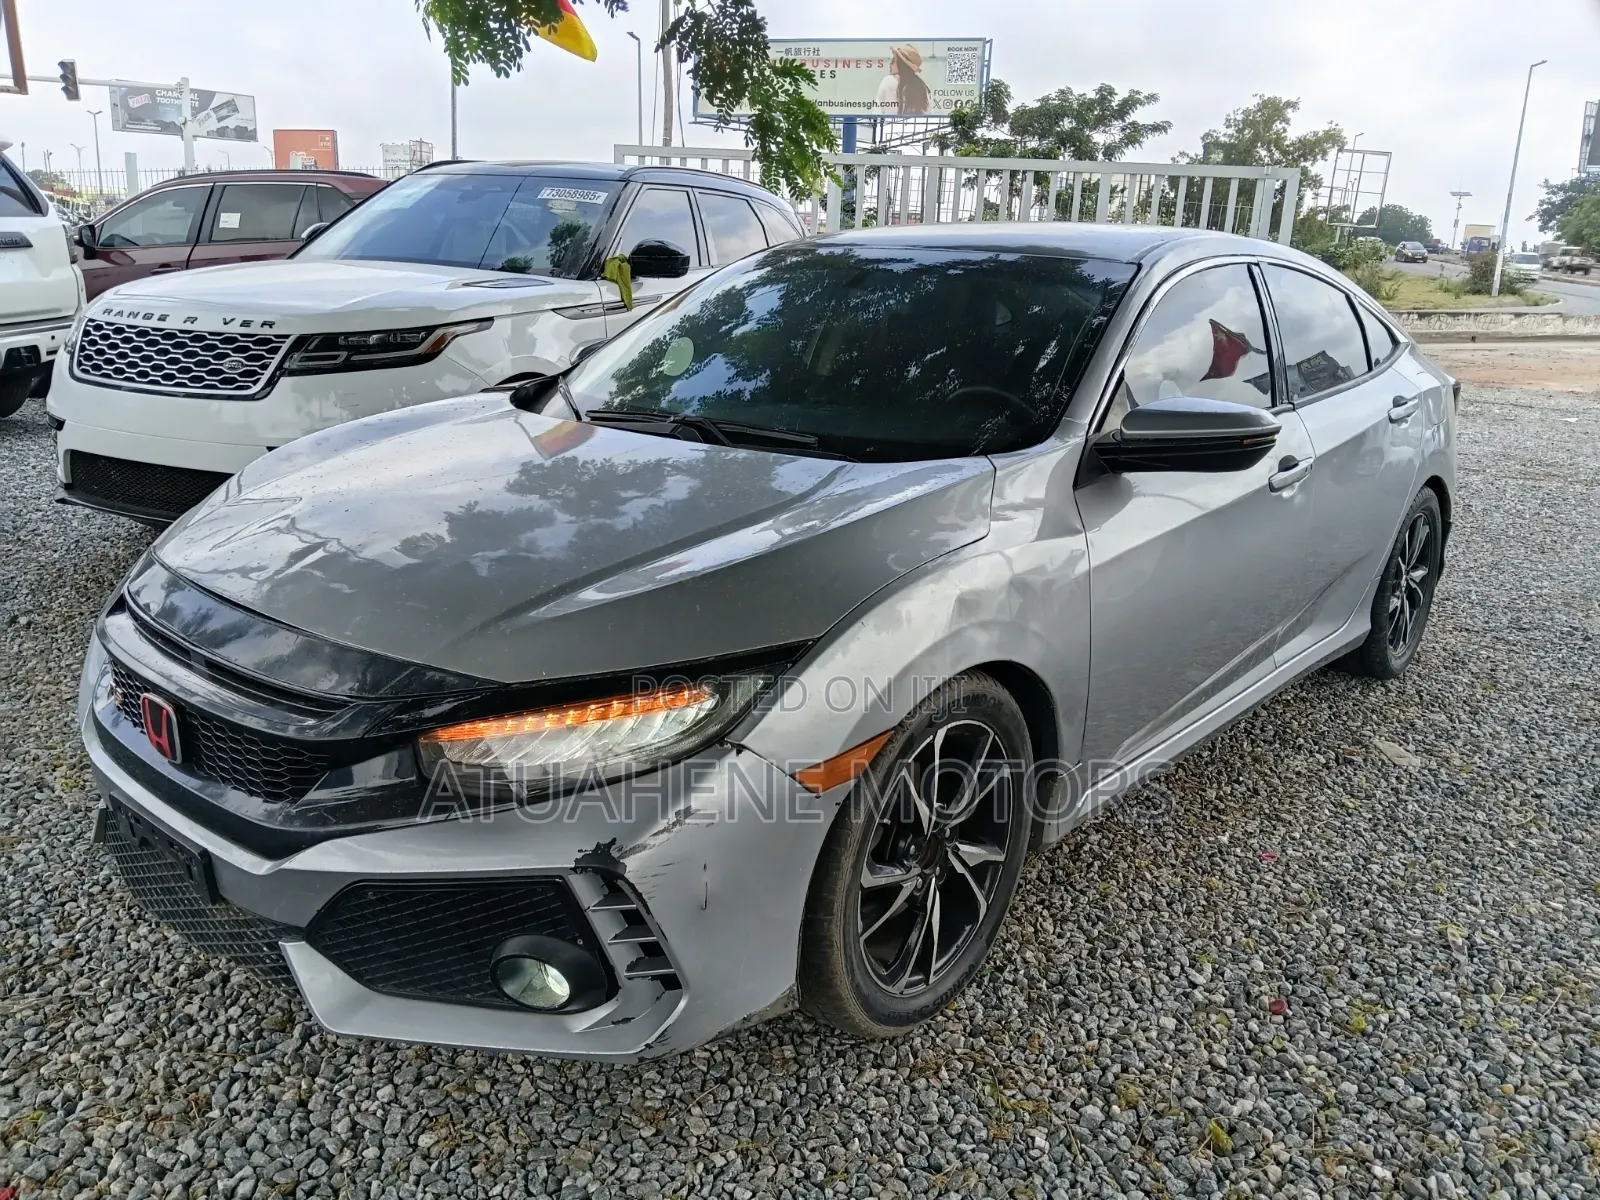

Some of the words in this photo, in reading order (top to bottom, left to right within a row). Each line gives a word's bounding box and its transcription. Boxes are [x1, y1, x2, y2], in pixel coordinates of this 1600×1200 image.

[776, 47, 820, 57] 一帆旅行社
[801, 59, 884, 68] BUSINESS
[102, 308, 170, 322] RANGE
